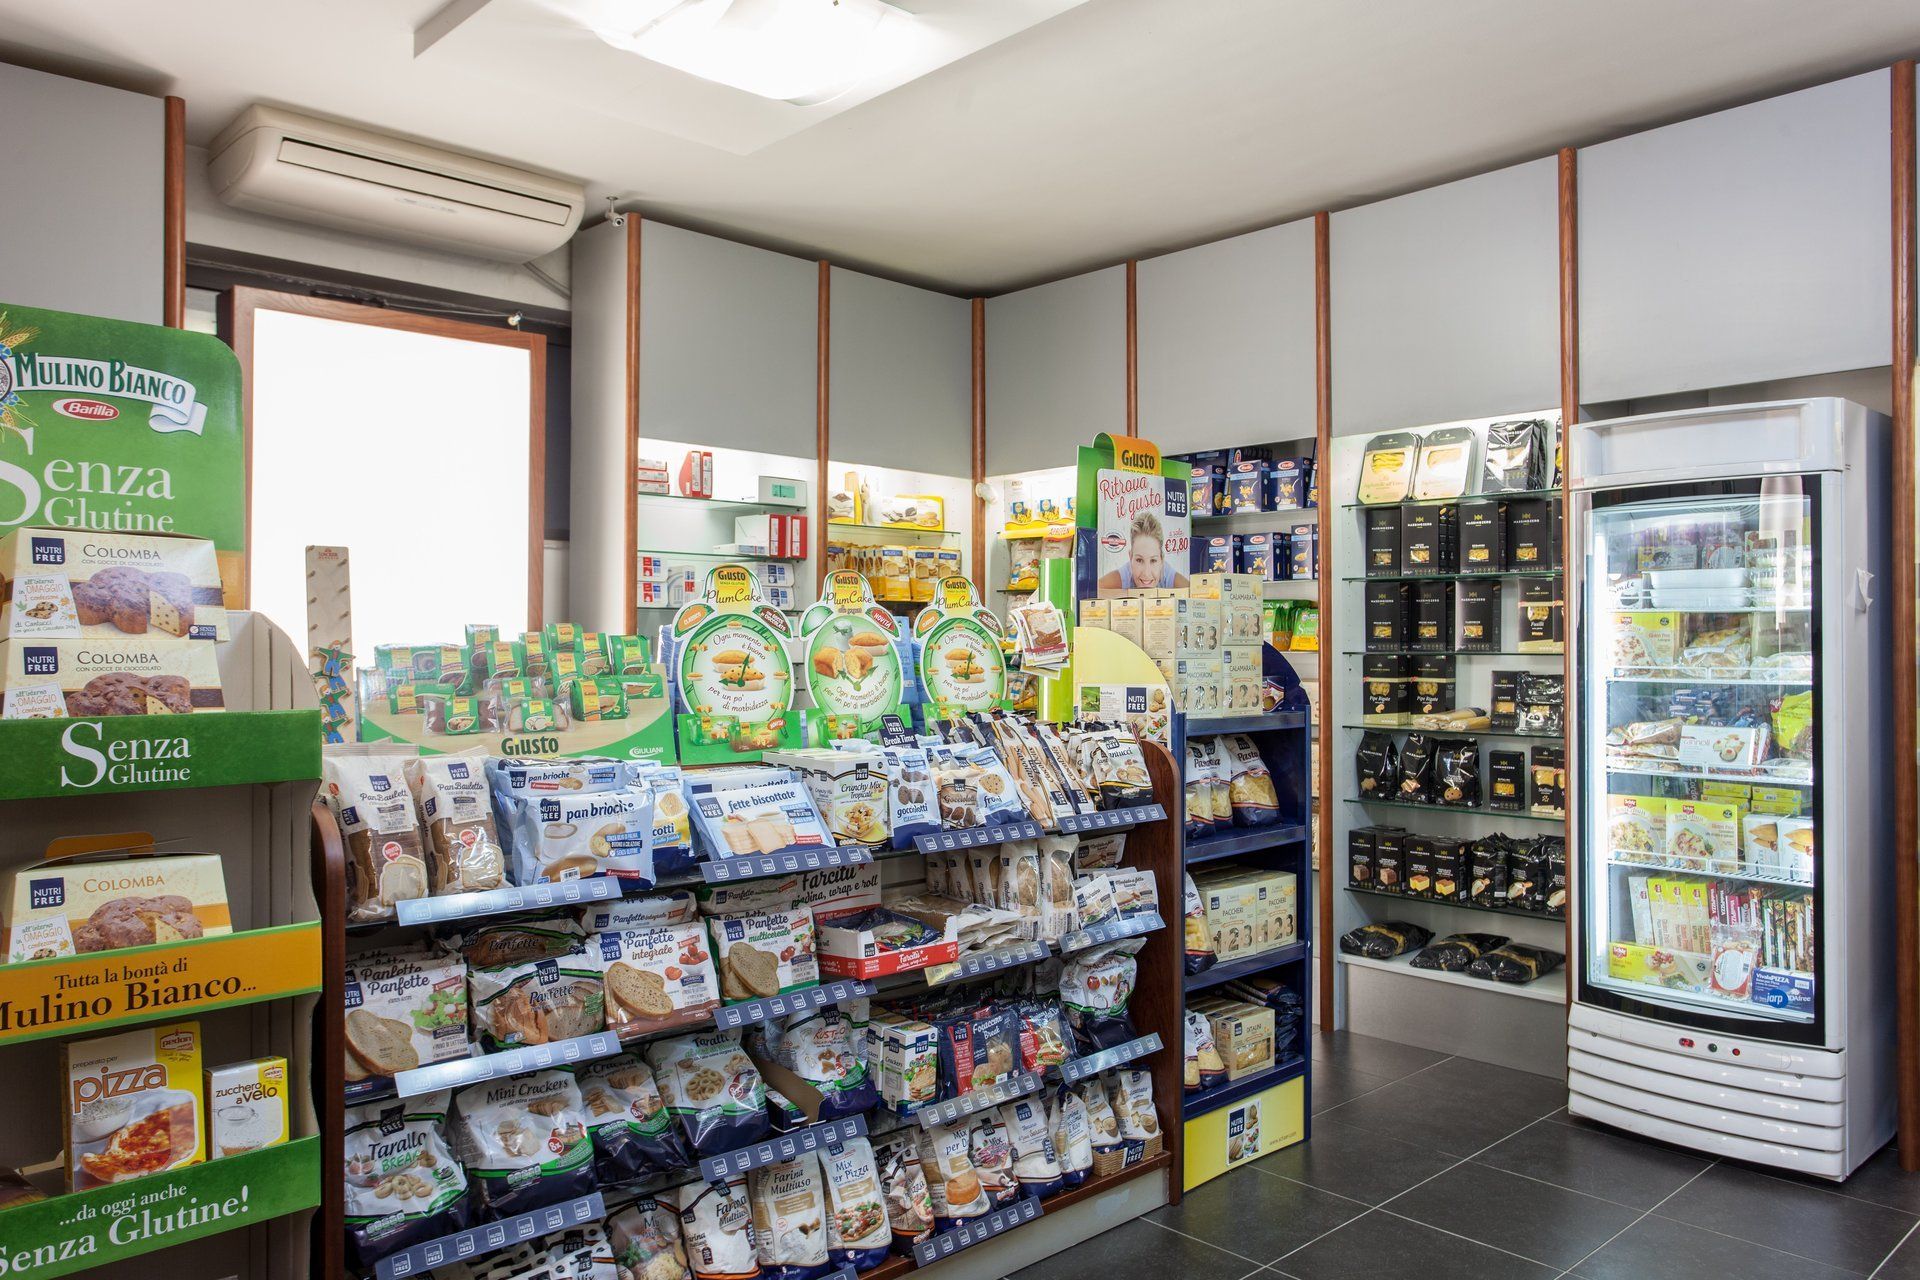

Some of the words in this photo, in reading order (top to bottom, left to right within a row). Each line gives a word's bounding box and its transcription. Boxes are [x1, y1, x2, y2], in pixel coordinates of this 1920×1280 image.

[15, 352, 104, 388] MULINO
[109, 358, 186, 405] BIANCO
[68, 402, 114, 417] Barilla
[1122, 450, 1155, 469] Giusto
[1100, 476, 1147, 501] Ritrova
[1167, 492, 1186, 501] NUTRI
[1117, 496, 1125, 520] il
[1128, 489, 1162, 521] gusto
[1167, 502, 1186, 513] FREE
[44, 497, 174, 533] Glutine
[35, 545, 62, 555] NUTRI
[1165, 538, 1188, 552] €2,80
[83, 544, 161, 560] COLOMBA
[35, 554, 63, 563] FREE
[718, 570, 746, 581] Giusto
[835, 575, 858, 585] Giusto
[945, 581, 967, 589] Giusto
[706, 588, 762, 604] PlumCake
[826, 590, 871, 605] PlumCake
[937, 595, 979, 609] PlumCake
[1230, 593, 1257, 601] CALAMARATA
[712, 633, 731, 646] Ogni
[733, 632, 762, 647] momento
[944, 634, 956, 645] Ogni
[77, 651, 158, 664] COLOMBA
[747, 644, 766, 660] buono
[27, 656, 55, 664] NUTRI
[28, 663, 56, 672] FREE
[707, 686, 721, 698] per
[823, 687, 835, 697] per
[836, 686, 849, 698] Ogni
[732, 698, 769, 712] morbidezza
[1128, 703, 1145, 711] FREE
[501, 736, 560, 755] Giusto
[634, 747, 663, 755] GIULIANI
[61, 722, 191, 788] Senza
[109, 762, 191, 784] Glutine
[529, 774, 542, 783] pan
[543, 771, 570, 780] brioche
[841, 784, 867, 793] Crunchy
[868, 782, 881, 791] Mix
[850, 791, 873, 799] Tropicale
[728, 801, 750, 813] fette
[753, 790, 795, 808] biscottate
[541, 805, 559, 813] NUTRI
[701, 804, 717, 813] NUTRI
[566, 808, 589, 823] pan
[83, 875, 164, 893] COLOMBA
[829, 885, 853, 896] wrap
[861, 875, 878, 888] roll
[34, 887, 61, 897] NUTRI
[728, 891, 754, 901] Panfette
[35, 896, 62, 905] FREE
[1269, 898, 1286, 906] PACCHERI
[1223, 907, 1243, 917] PACCHERI
[613, 915, 645, 923] Panfette
[746, 916, 788, 931] Panfette
[749, 928, 791, 943] multicereale
[624, 935, 674, 949] Panfette
[601, 945, 620, 953] NUTRI
[603, 951, 620, 959] FREE
[632, 946, 673, 961] integrale
[54, 974, 99, 991] Tutta
[104, 971, 118, 984] la
[123, 962, 168, 980] bontà
[172, 957, 188, 972] di
[538, 967, 557, 975] NUTRI
[368, 975, 430, 995] Panfette
[540, 974, 558, 985] FREE
[124, 975, 257, 1012] Bianco...
[984, 1027, 1000, 1039] Break
[693, 1034, 729, 1047] Taralli
[106, 1056, 118, 1064] per
[73, 1063, 168, 1114] pizza
[216, 1083, 262, 1097] zucchero
[243, 1085, 277, 1102] velo
[486, 1086, 516, 1104] Mini
[519, 1078, 568, 1097] Crackers
[1019, 1112, 1032, 1120] FREE
[1231, 1117, 1243, 1127] NUTRI
[953, 1130, 967, 1139] Mix
[1231, 1124, 1243, 1134] FREE
[369, 1132, 427, 1160] Tarallo
[989, 1138, 1003, 1146] Mix
[946, 1143, 960, 1155] per
[1128, 1146, 1143, 1155] NUTRI
[382, 1150, 419, 1172] BREAK
[1127, 1152, 1142, 1163] FREE
[836, 1162, 852, 1172] Mix
[845, 1164, 869, 1180] Pizza
[774, 1168, 804, 1183] Farina
[771, 1178, 811, 1195] Multiuso
[101, 1194, 135, 1218] oggi
[141, 1184, 187, 1205] anche
[109, 1185, 249, 1246] Glutine!
